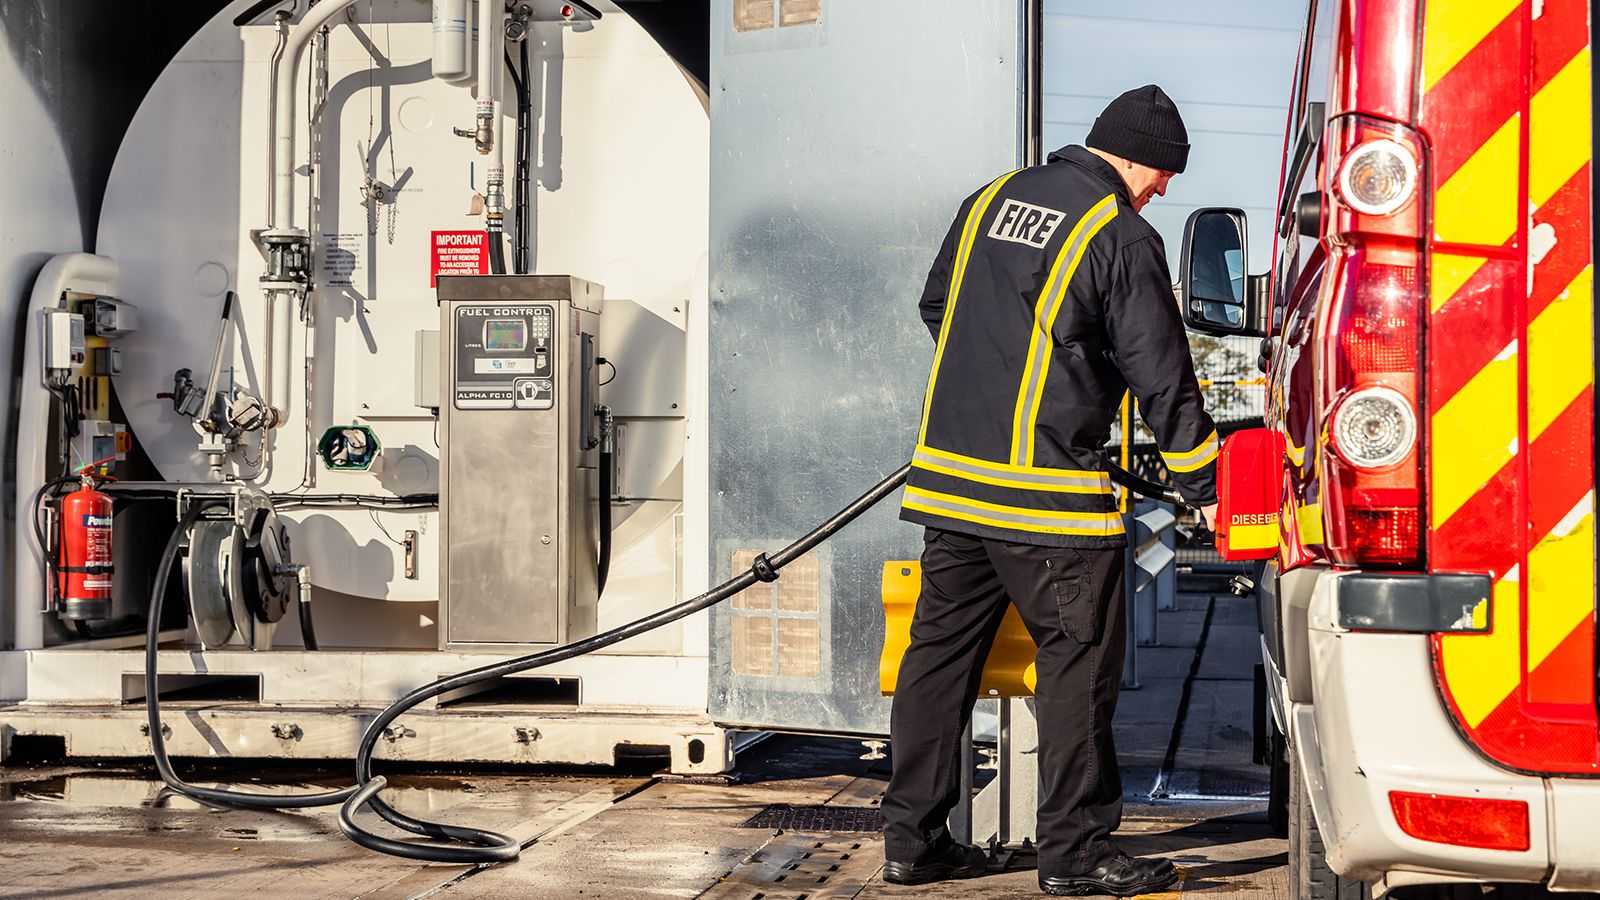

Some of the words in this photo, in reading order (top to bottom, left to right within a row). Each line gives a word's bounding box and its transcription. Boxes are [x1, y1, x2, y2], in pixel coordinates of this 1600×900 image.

[995, 204, 1059, 244] FIRE
[436, 234, 483, 245] IMPORTANT
[460, 308, 489, 316] FUEL
[493, 308, 549, 316] CONTROL
